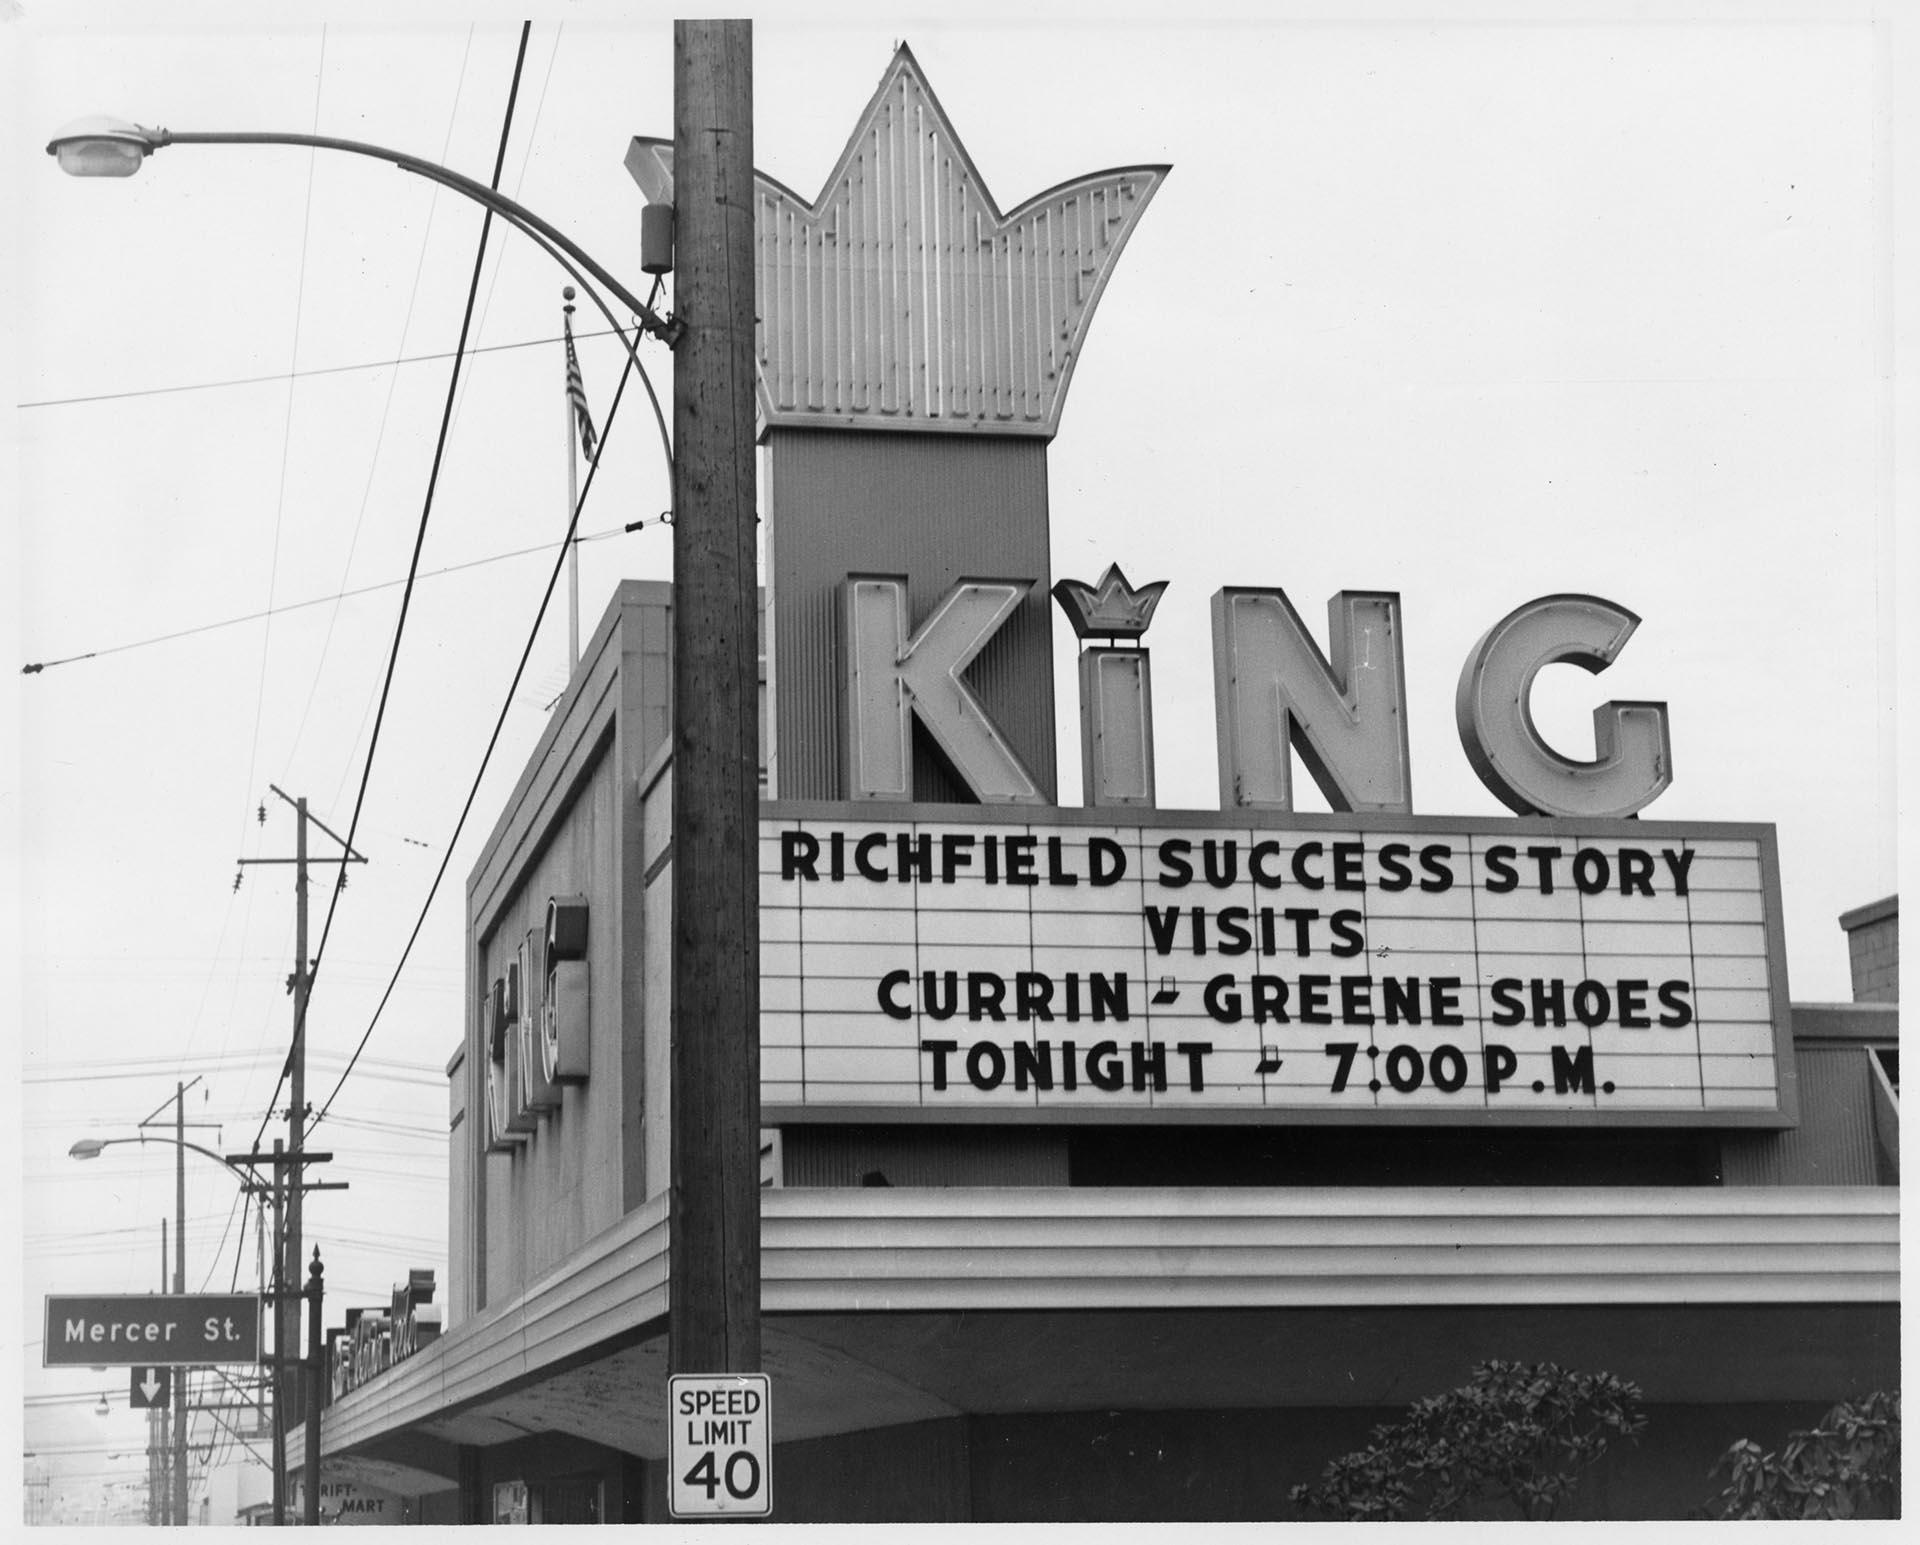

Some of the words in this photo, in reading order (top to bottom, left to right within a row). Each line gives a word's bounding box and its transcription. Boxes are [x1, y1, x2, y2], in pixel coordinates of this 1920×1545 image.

[781, 830, 1127, 888] RICHFIELD
[1158, 838, 1454, 893] SUCCESS
[1484, 845, 1695, 897] STORY
[1144, 905, 1364, 957] VISITS
[877, 970, 1130, 1022] CURRIN
[1203, 973, 1465, 1026] GREENE
[1491, 978, 1693, 1028] SHOES
[921, 1040, 1214, 1092] TONIGHT
[64, 1318, 177, 1343] Mercer
[204, 1317, 241, 1342] St.
[679, 1390, 761, 1416] SPEED
[688, 1420, 752, 1446] LIMIT
[302, 1483, 357, 1497] RIFT-
[682, 1450, 761, 1500] 40
[342, 1499, 384, 1513] MART
